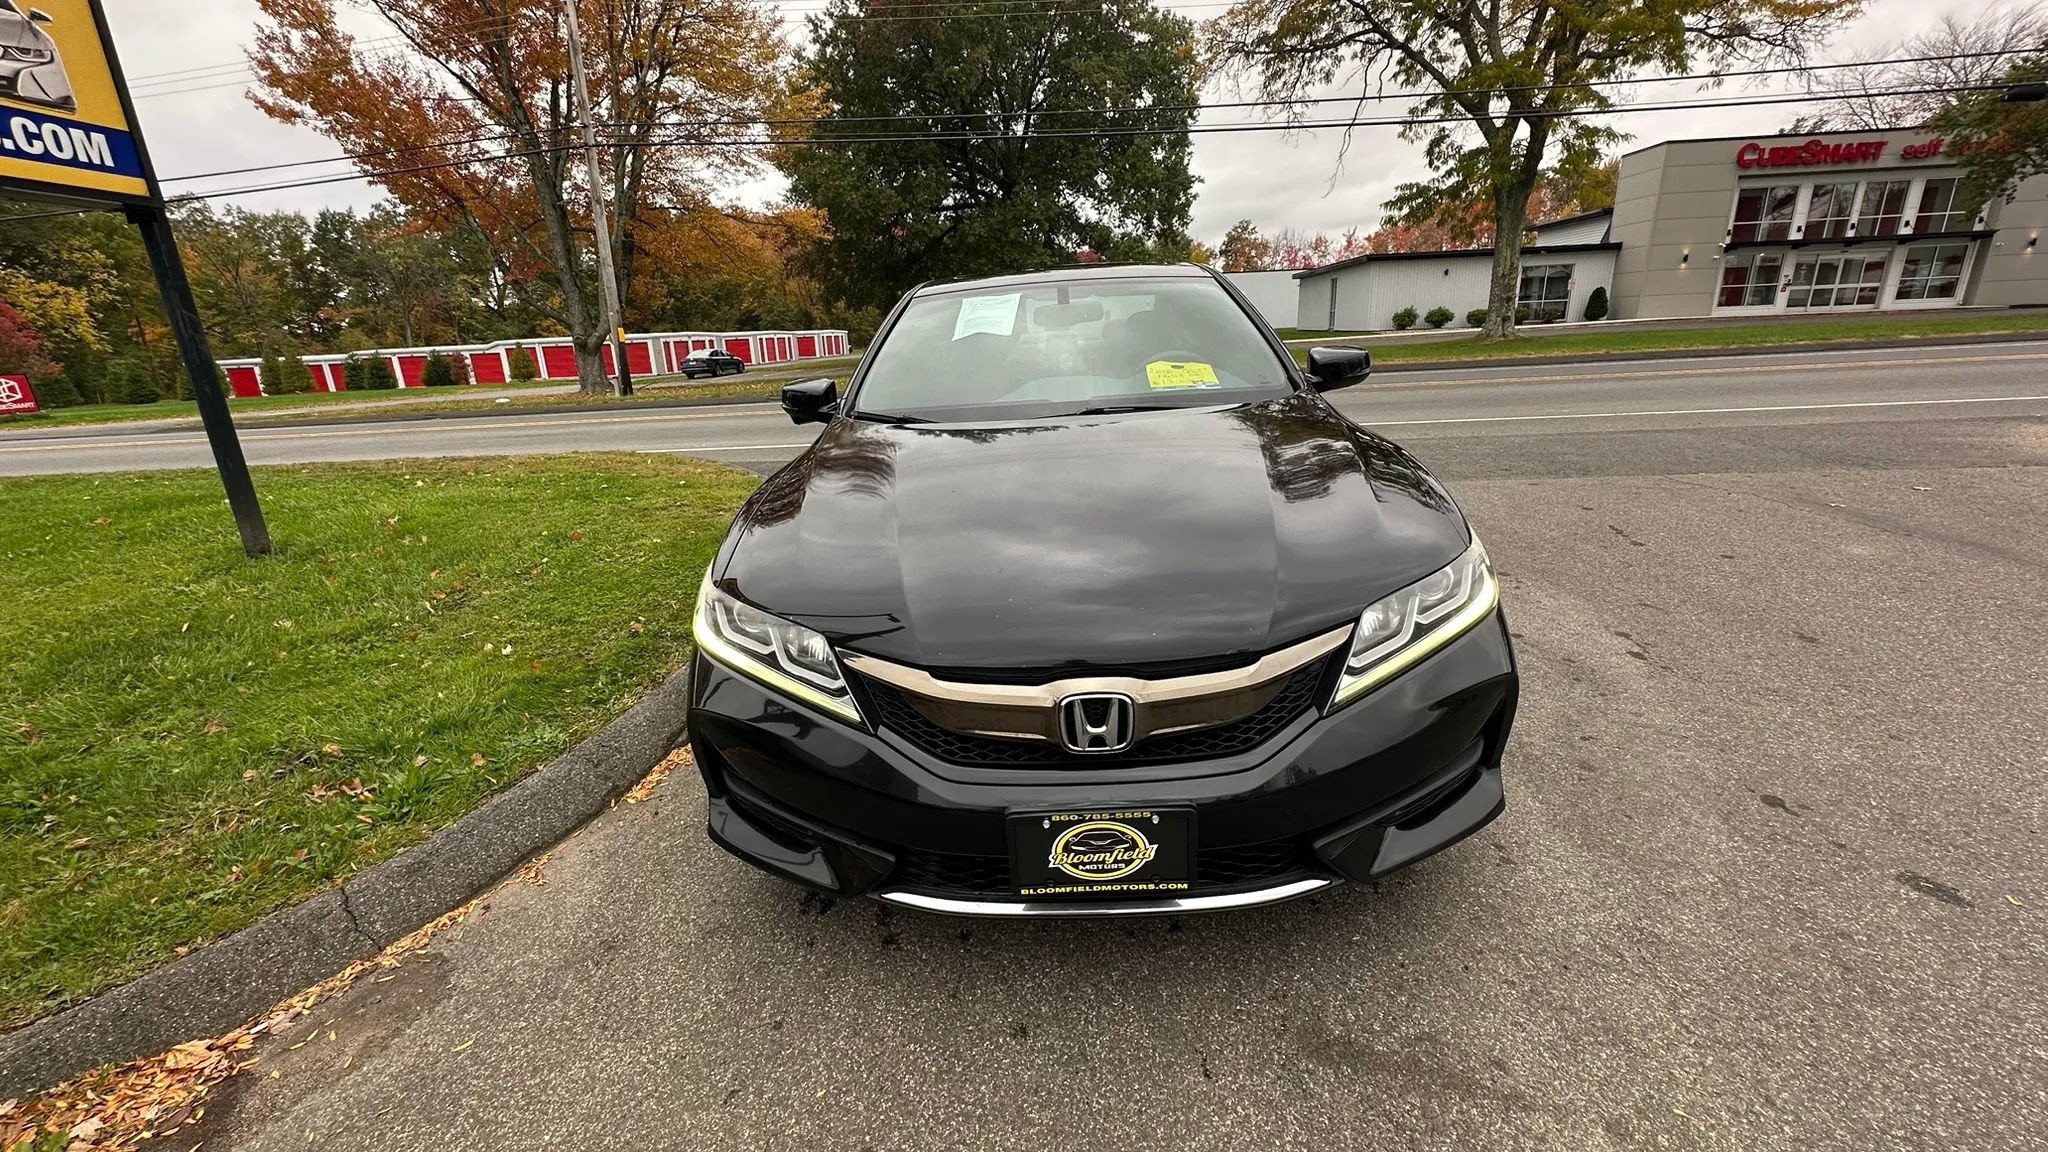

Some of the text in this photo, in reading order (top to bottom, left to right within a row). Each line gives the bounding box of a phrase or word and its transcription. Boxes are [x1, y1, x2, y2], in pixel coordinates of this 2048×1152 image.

[1736, 139, 1888, 169] CUBESMART
[1902, 138, 1945, 160] self
[1051, 811, 1151, 822] 860-785-5555
[1053, 847, 1152, 866] Bloomfield
[1078, 863, 1126, 871] MOTORS
[1020, 882, 1189, 895] BLOOMFIELDMOTORS.COM
